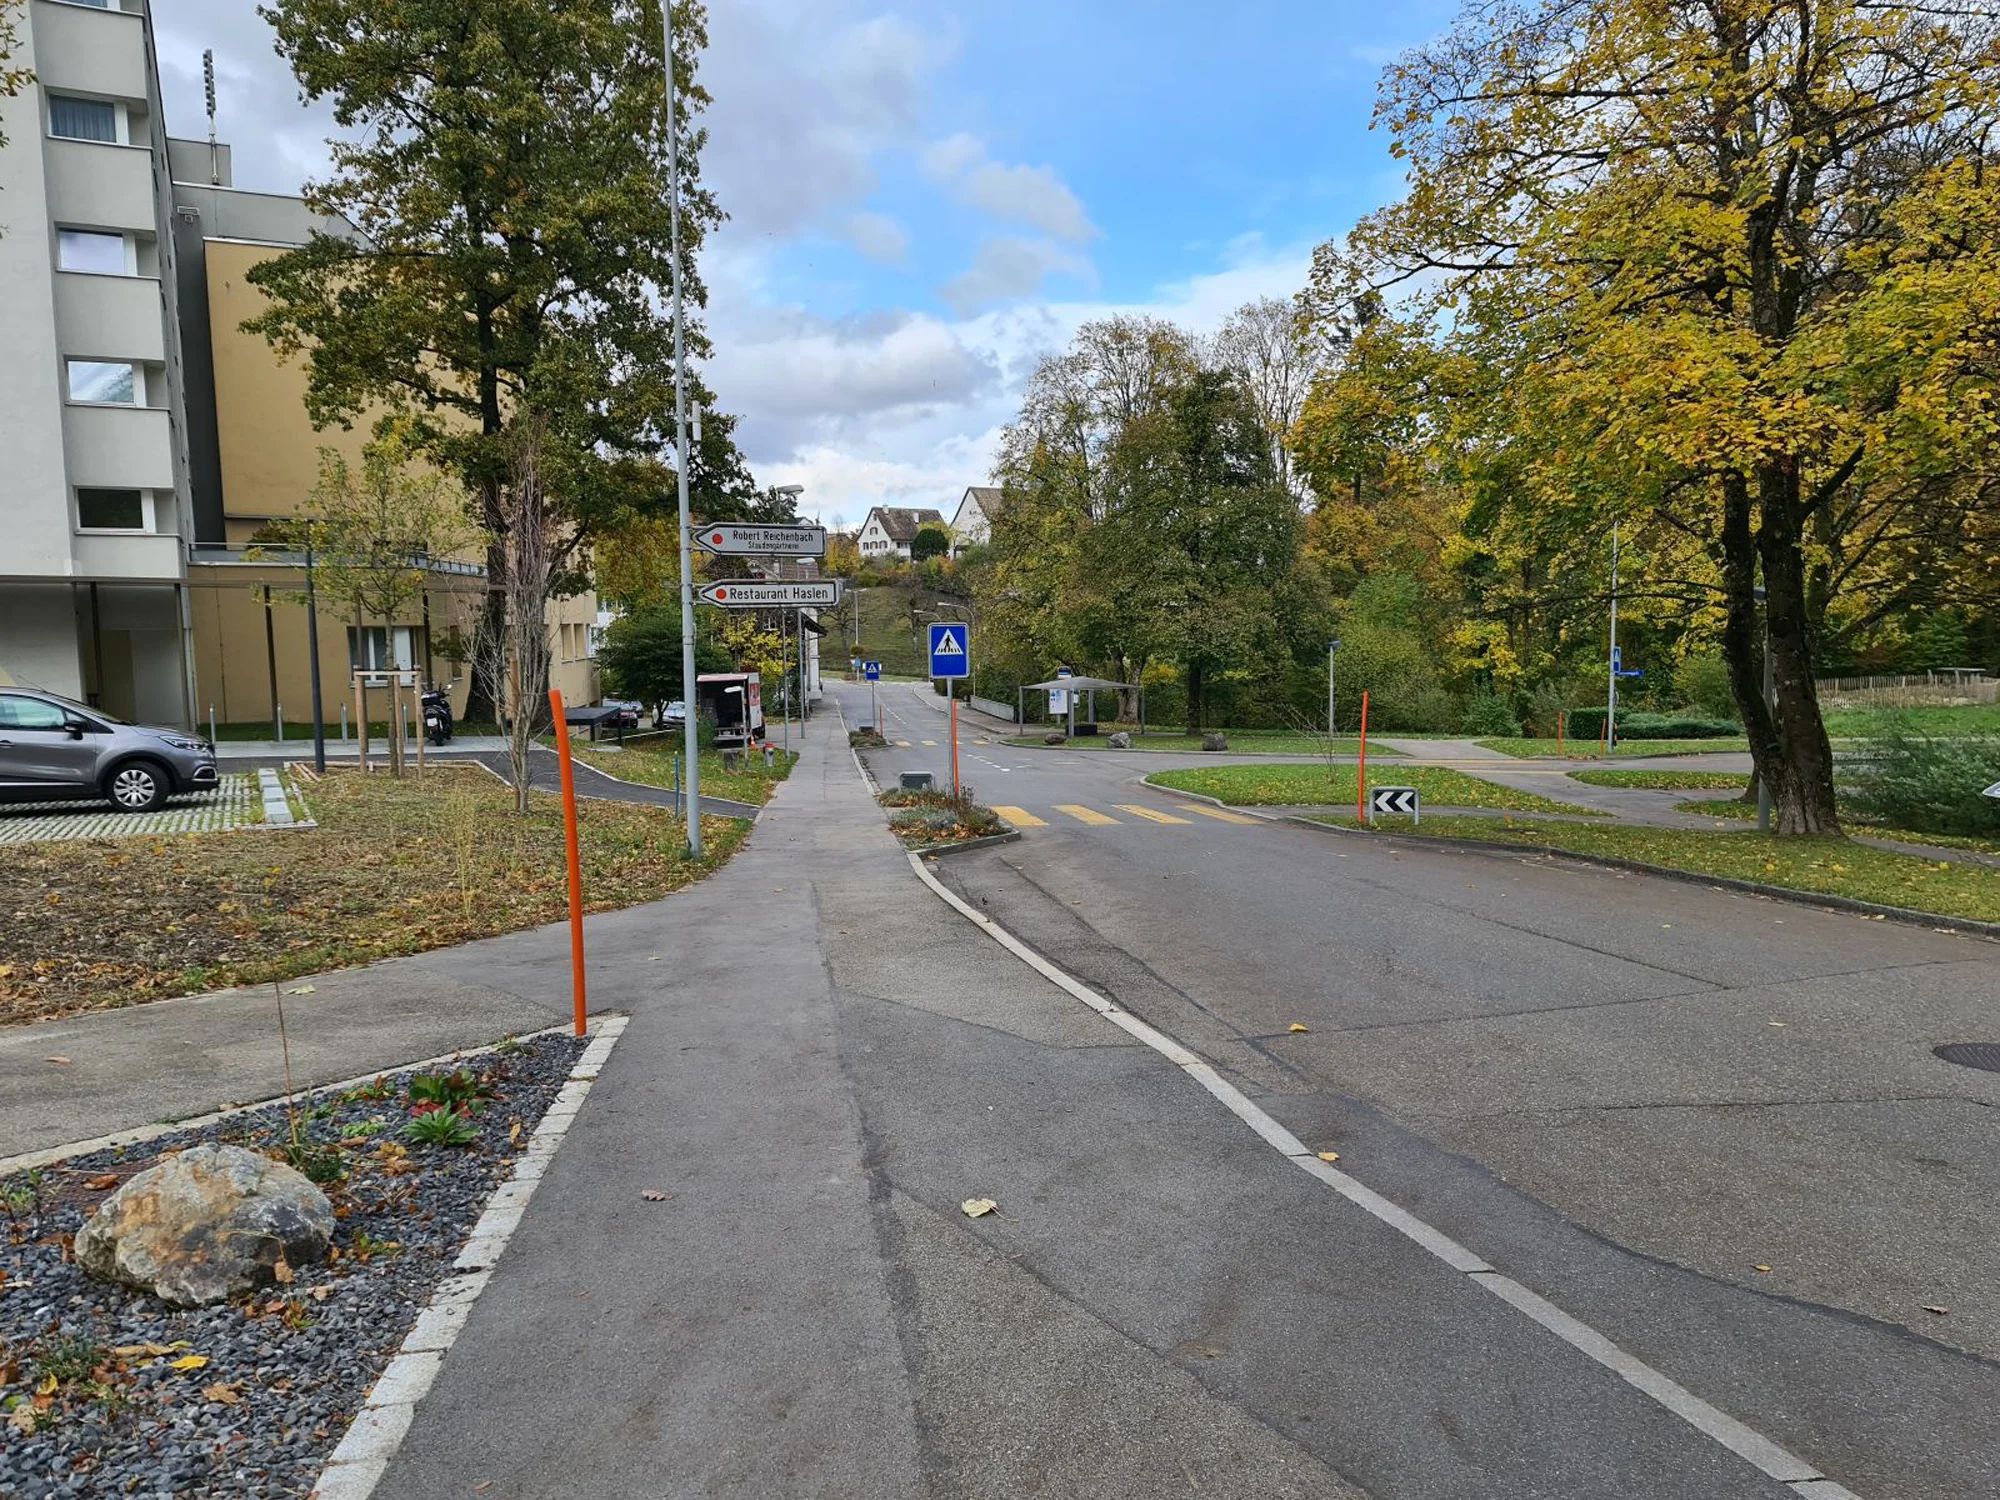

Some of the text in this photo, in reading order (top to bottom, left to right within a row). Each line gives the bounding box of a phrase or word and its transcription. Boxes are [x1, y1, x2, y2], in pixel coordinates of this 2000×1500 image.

[733, 530, 814, 542] Robert Reichenbach
[729, 587, 828, 600] Restaurant Haslen
